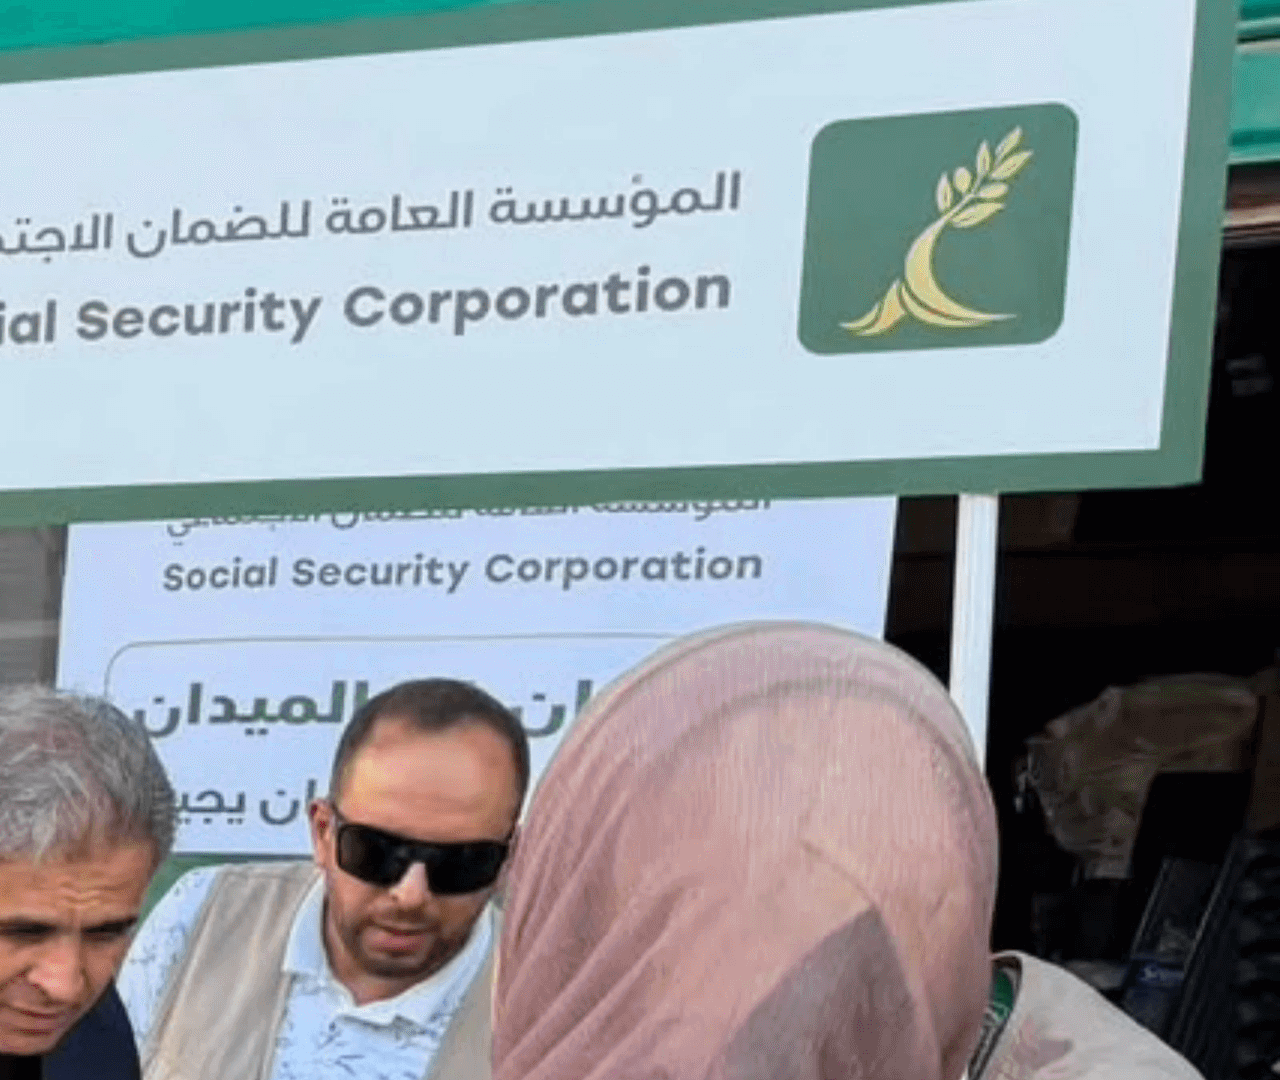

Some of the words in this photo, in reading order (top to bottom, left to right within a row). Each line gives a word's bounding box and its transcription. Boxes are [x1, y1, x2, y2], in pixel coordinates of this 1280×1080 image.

[325, 189, 474, 235] العامة
[488, 170, 741, 228] المؤسسة
[126, 199, 312, 260] للضمان
[75, 286, 323, 345] Security
[343, 264, 732, 337] Corporation
[162, 555, 279, 593] Social
[291, 552, 471, 595] Security
[484, 545, 763, 592] Corporation
[176, 789, 246, 825] يجي
